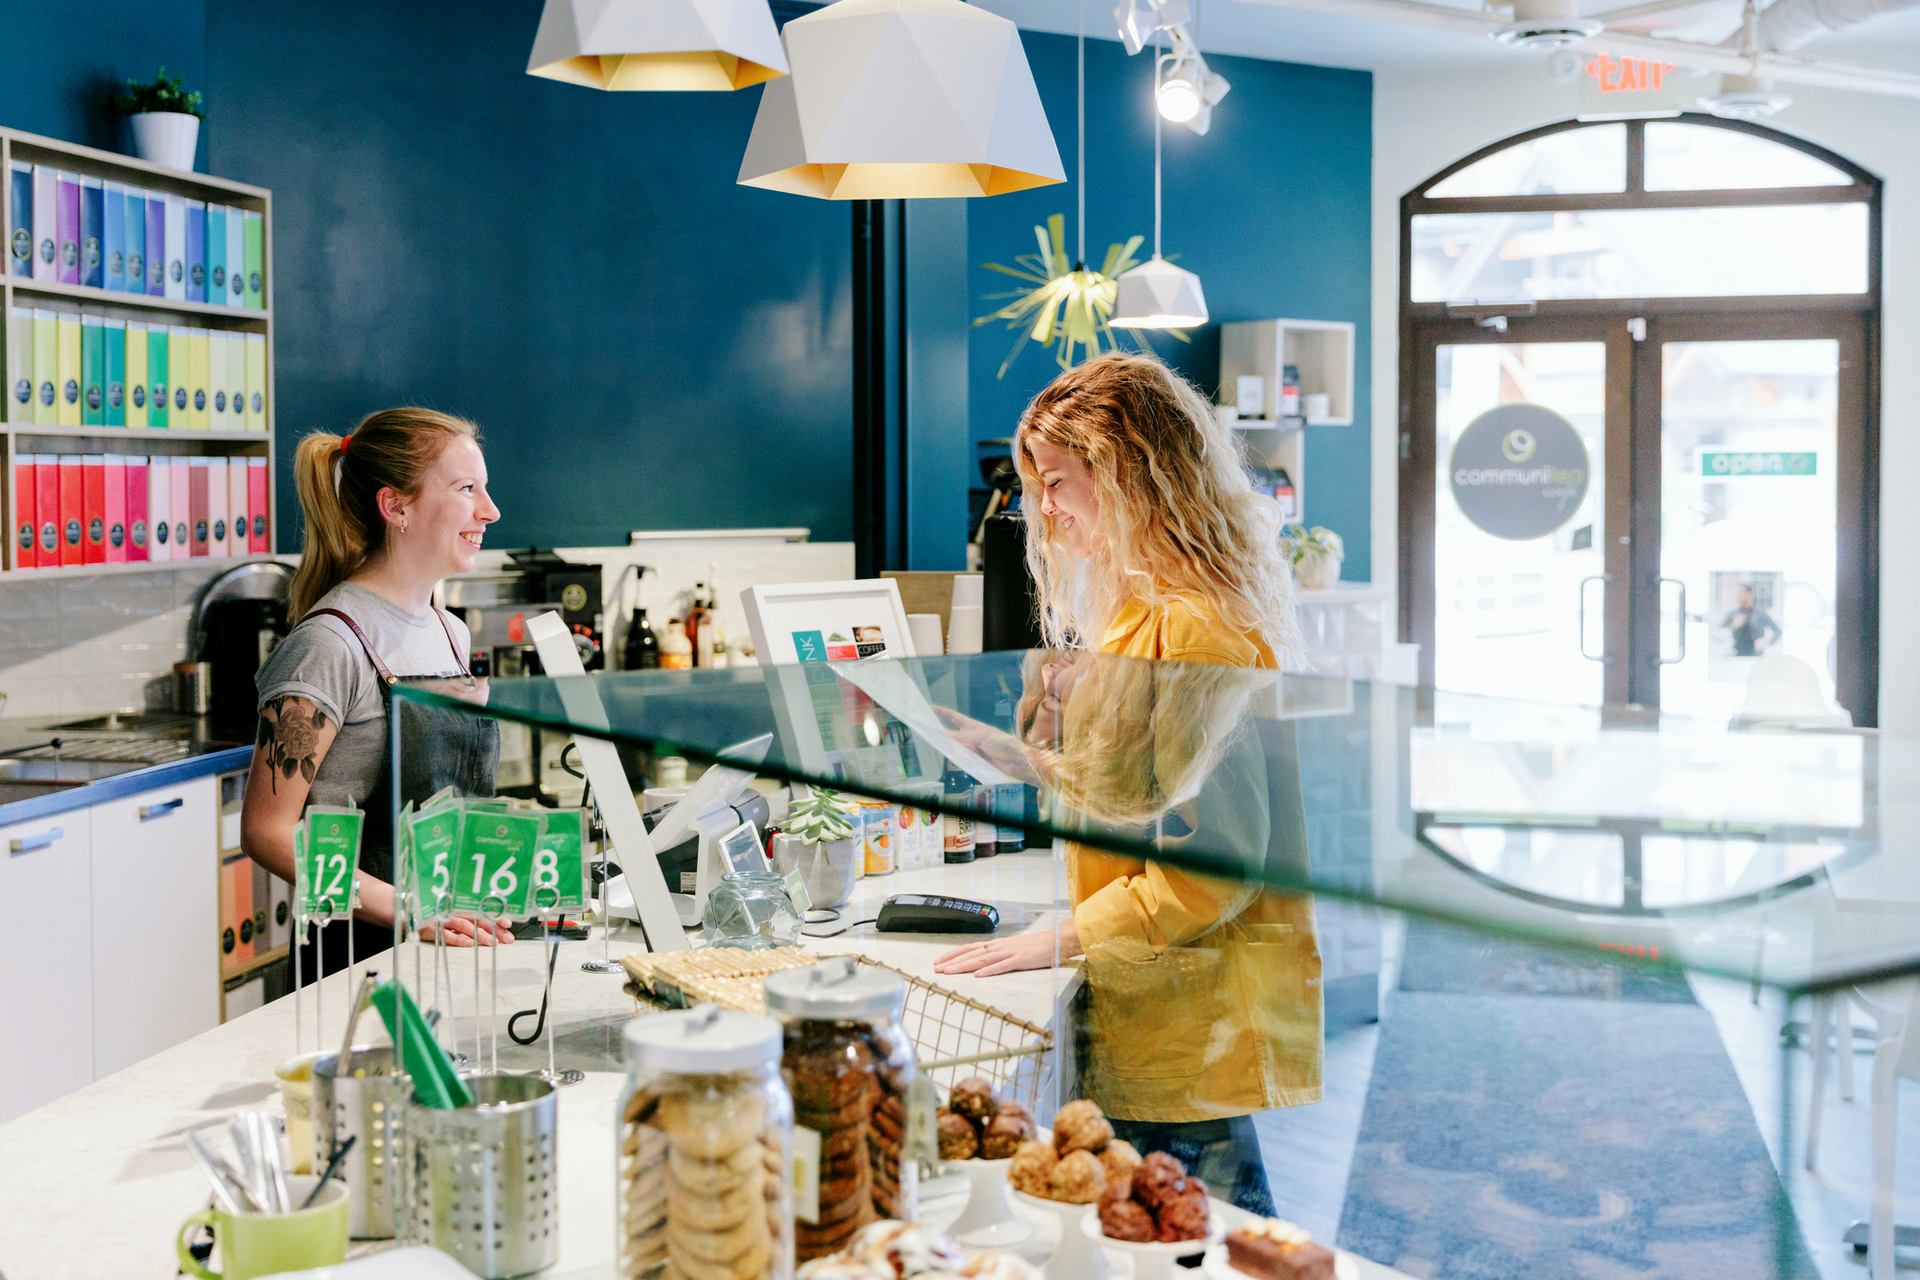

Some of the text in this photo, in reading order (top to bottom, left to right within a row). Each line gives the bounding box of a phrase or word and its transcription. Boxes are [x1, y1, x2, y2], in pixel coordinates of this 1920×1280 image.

[1711, 454, 1783, 475] open
[314, 854, 348, 896] 12
[431, 851, 451, 897] 5
[472, 853, 519, 898] 16
[534, 848, 560, 889] 8
